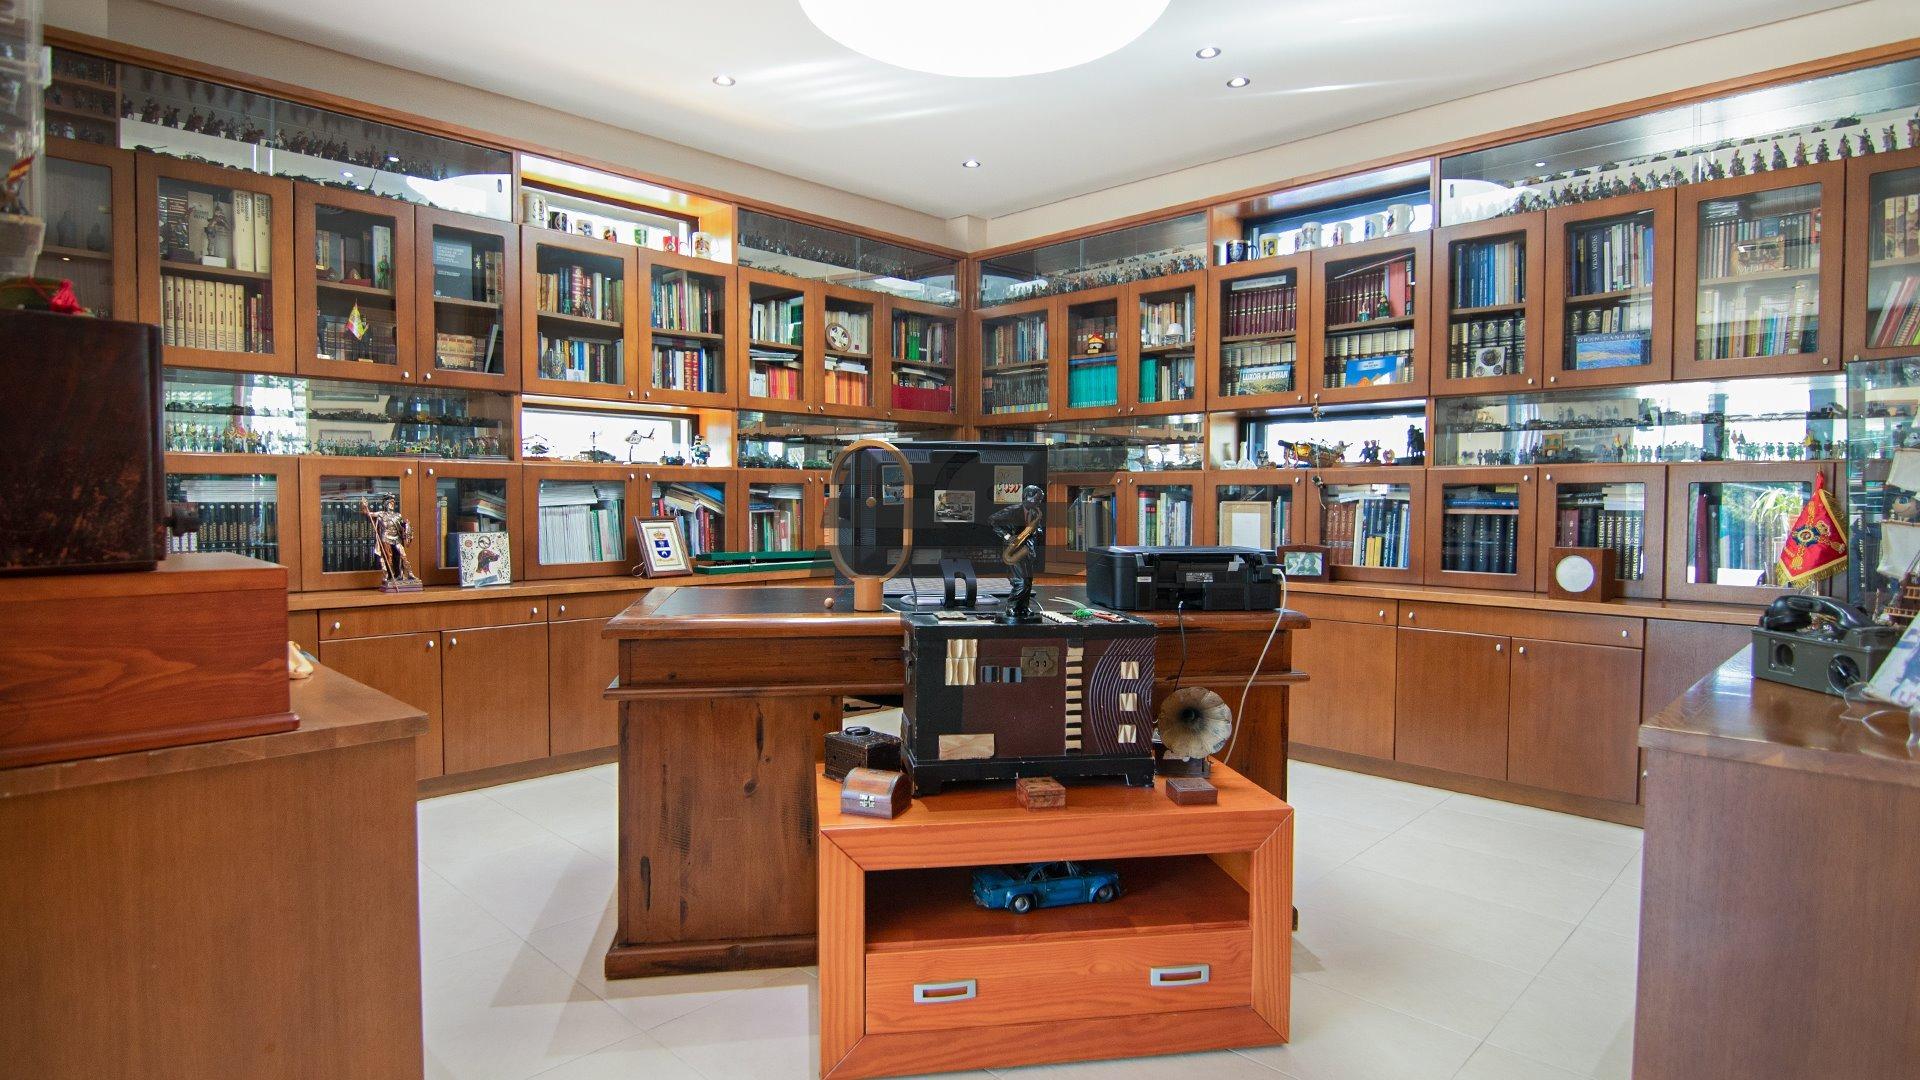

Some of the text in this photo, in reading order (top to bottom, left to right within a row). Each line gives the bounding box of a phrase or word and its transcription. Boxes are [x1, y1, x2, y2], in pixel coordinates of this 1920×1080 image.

[1602, 333, 1640, 342] CANARIA
[1242, 372, 1260, 380] LUXOR
[1267, 370, 1288, 379] ASWAN
